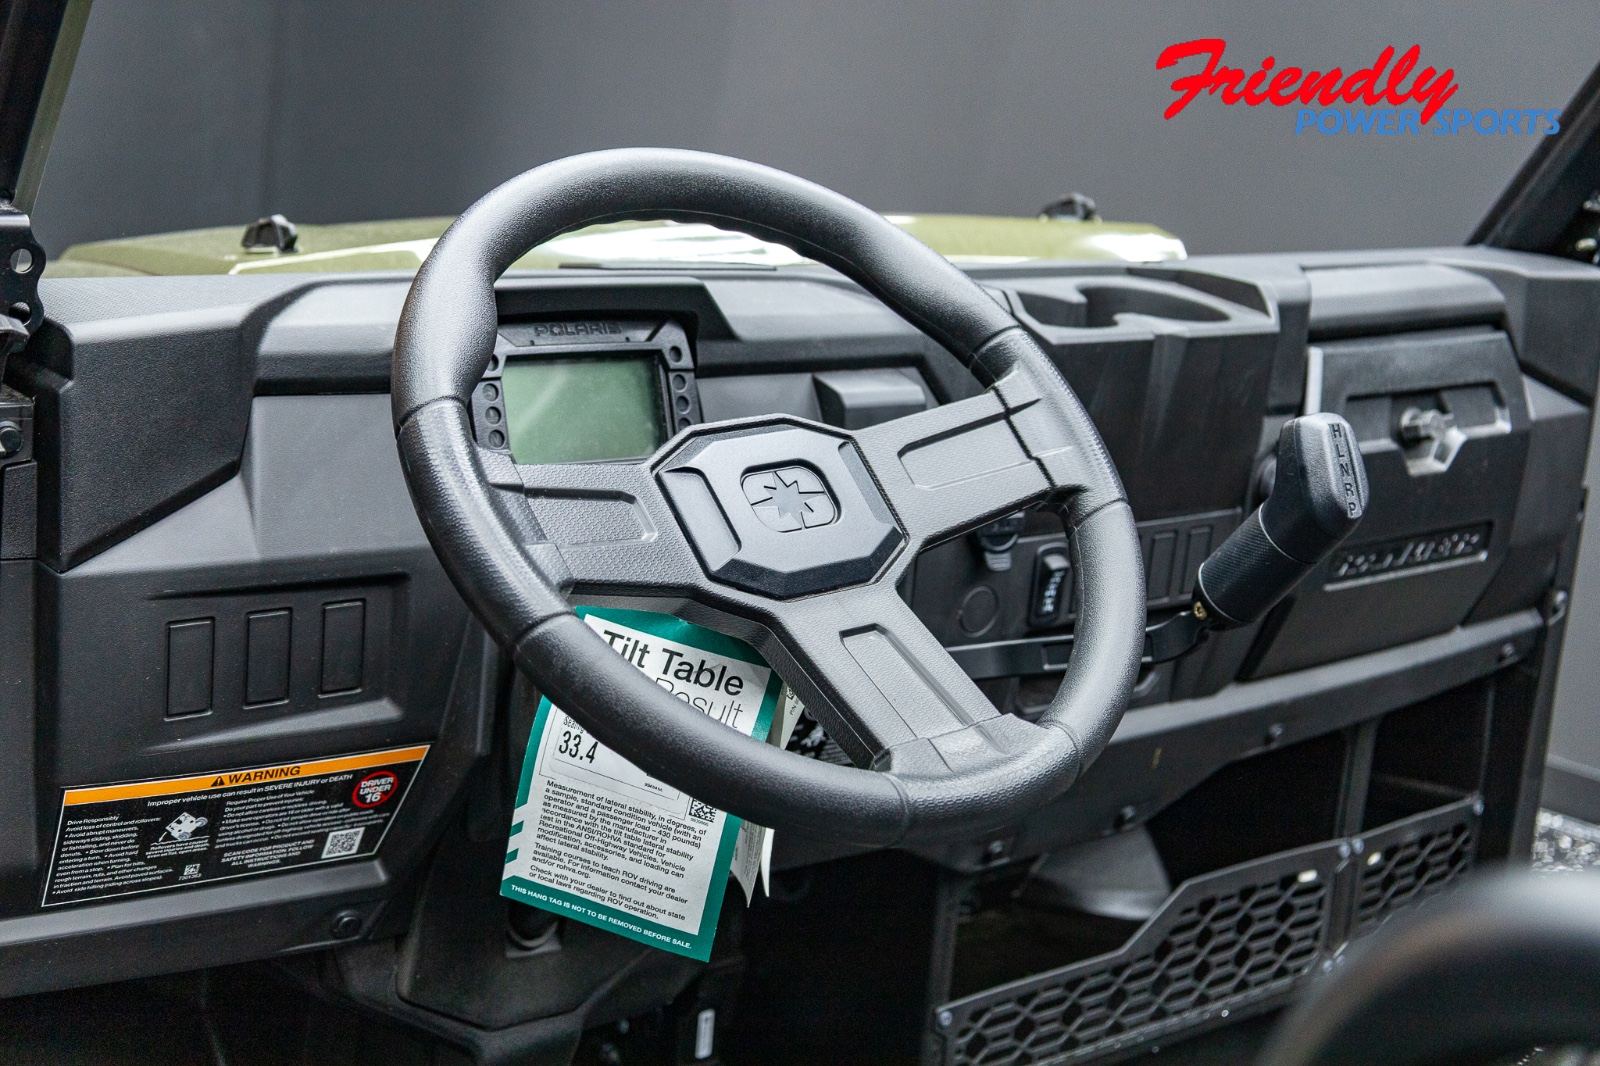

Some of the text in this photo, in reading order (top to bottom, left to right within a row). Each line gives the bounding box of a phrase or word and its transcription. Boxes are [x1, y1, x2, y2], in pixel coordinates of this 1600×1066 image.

[533, 323, 623, 337] POLARIS
[1331, 423, 1343, 439] H
[1340, 462, 1351, 477] N
[603, 630, 744, 696] Tilt Table
[559, 731, 598, 763] 33.4
[147, 798, 181, 806] Improper
[182, 794, 207, 802] vehicle
[264, 782, 293, 791] SEVERE
[293, 778, 320, 787] INJURY
[328, 774, 352, 782] DEATH
[228, 765, 300, 783] WARNING
[359, 784, 390, 794] UNDER
[360, 777, 393, 787] DRIVER
[365, 791, 381, 802] 16
[546, 780, 594, 799] Measurement
[604, 797, 626, 809] lateral
[83, 813, 119, 823] Responsibly
[543, 794, 574, 806] operator
[596, 810, 633, 825] passenger
[634, 821, 650, 831] load
[657, 829, 670, 838] 430
[671, 835, 700, 849] pounds)
[551, 789, 578, 802] sample,
[580, 798, 612, 811] standard
[613, 808, 646, 822] condition
[647, 819, 672, 831] vehicle
[673, 827, 690, 837] (with
[552, 804, 587, 818] measured
[588, 813, 598, 822] by
[599, 817, 610, 825] the
[612, 822, 658, 841] manufacturer
[536, 833, 608, 860] affect lateral stability.
[537, 827, 683, 878] modification, accessories, and loading can
[538, 819, 685, 871] Recreational Off-Highway Vehicles. Vehicle
[563, 820, 574, 828] the
[575, 824, 621, 843] ANSI/ROHVA
[623, 840, 654, 854] standard
[584, 820, 598, 828] with
[600, 824, 611, 832] the
[624, 832, 641, 842] table
[642, 838, 664, 850] lateral
[665, 847, 693, 861] stability
[531, 856, 555, 866] and/or
[533, 849, 687, 903] available. For information contact your dealer
[534, 841, 562, 856] Training
[563, 852, 590, 864] courses
[601, 863, 620, 874] teach
[622, 870, 638, 880] ROV
[639, 877, 662, 890] driving
[530, 864, 552, 876] Check
[569, 877, 585, 886] your
[586, 883, 608, 894] dealer
[618, 893, 631, 902] find
[632, 899, 644, 907] out
[645, 904, 666, 914] about
[667, 911, 685, 920] state
[537, 873, 554, 883] local
[555, 879, 571, 888] laws
[573, 886, 605, 901] regarding
[606, 896, 623, 905] ROV
[511, 884, 526, 894] THIS
[527, 890, 547, 900] HANG
[549, 897, 562, 905] TAG
[571, 904, 586, 912] NOT
[608, 916, 642, 932] REMOVED
[643, 929, 670, 942] BEFORE
[672, 938, 693, 949] SALE.
